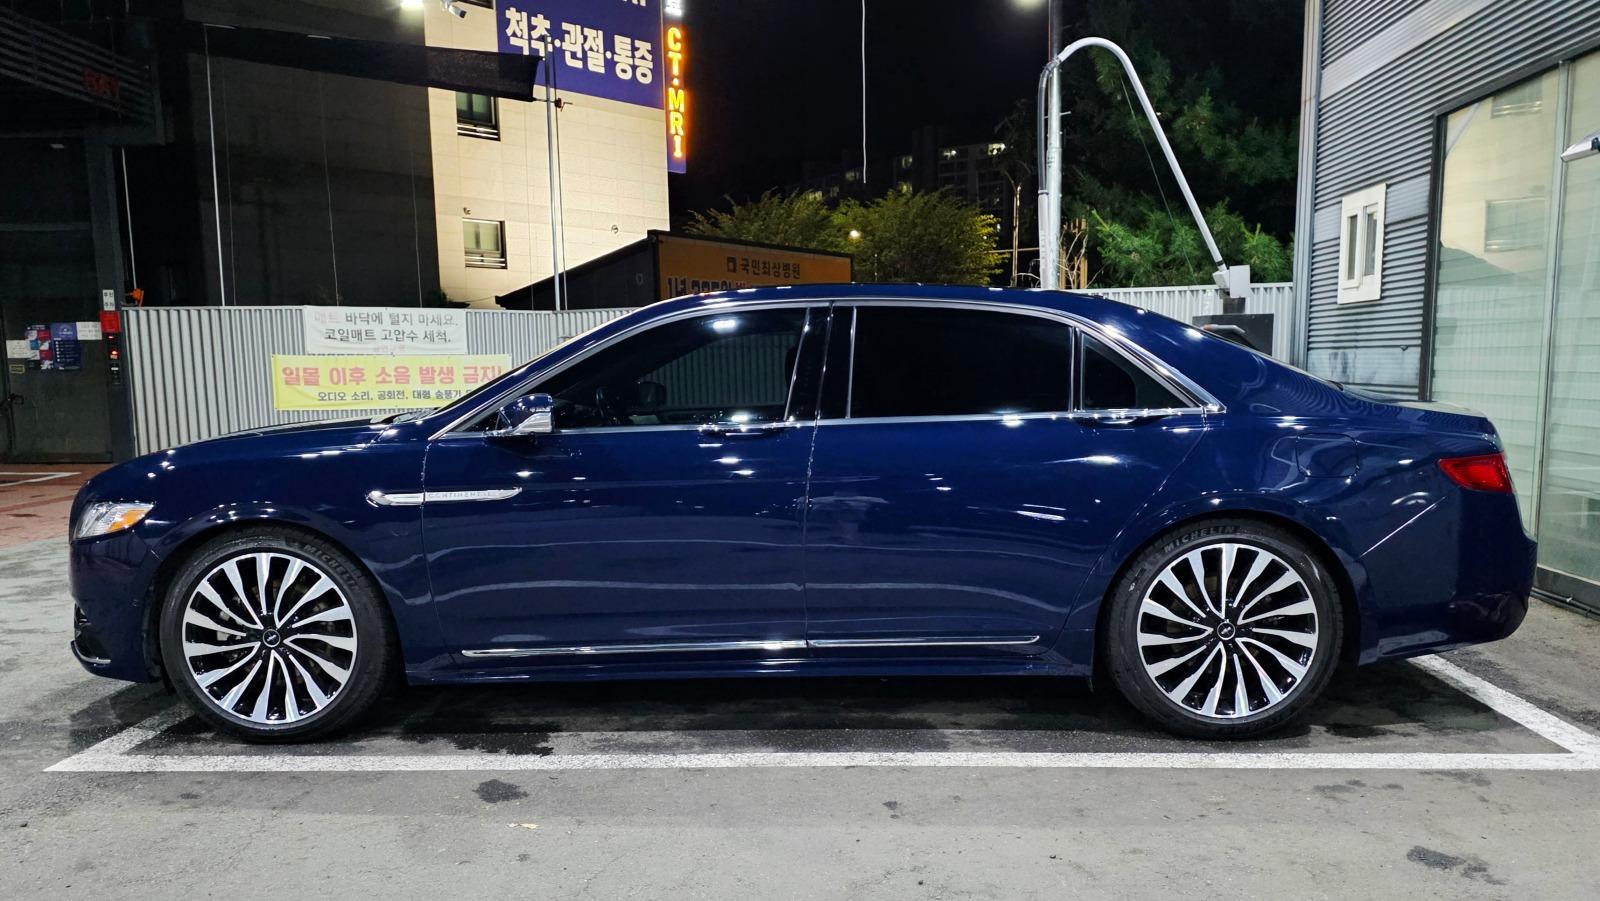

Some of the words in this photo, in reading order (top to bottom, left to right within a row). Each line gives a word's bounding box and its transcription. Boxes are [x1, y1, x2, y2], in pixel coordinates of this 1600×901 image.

[667, 26, 685, 158] CT·MRI
[345, 312, 383, 325] 바닥에
[389, 312, 413, 326] 털지
[418, 313, 459, 326] 마세요.
[324, 328, 377, 342] 코일매트
[381, 329, 418, 343] 고압수
[423, 330, 451, 343] 세척.
[282, 367, 320, 386] 일몰
[329, 366, 366, 385] 이후
[376, 365, 410, 384] 소음
[419, 366, 455, 385] 발생
[317, 391, 347, 401] 오디오
[412, 390, 431, 399] 대형
[435, 390, 461, 399] 송풍기
[1163, 525, 1234, 551] MICHELIN
